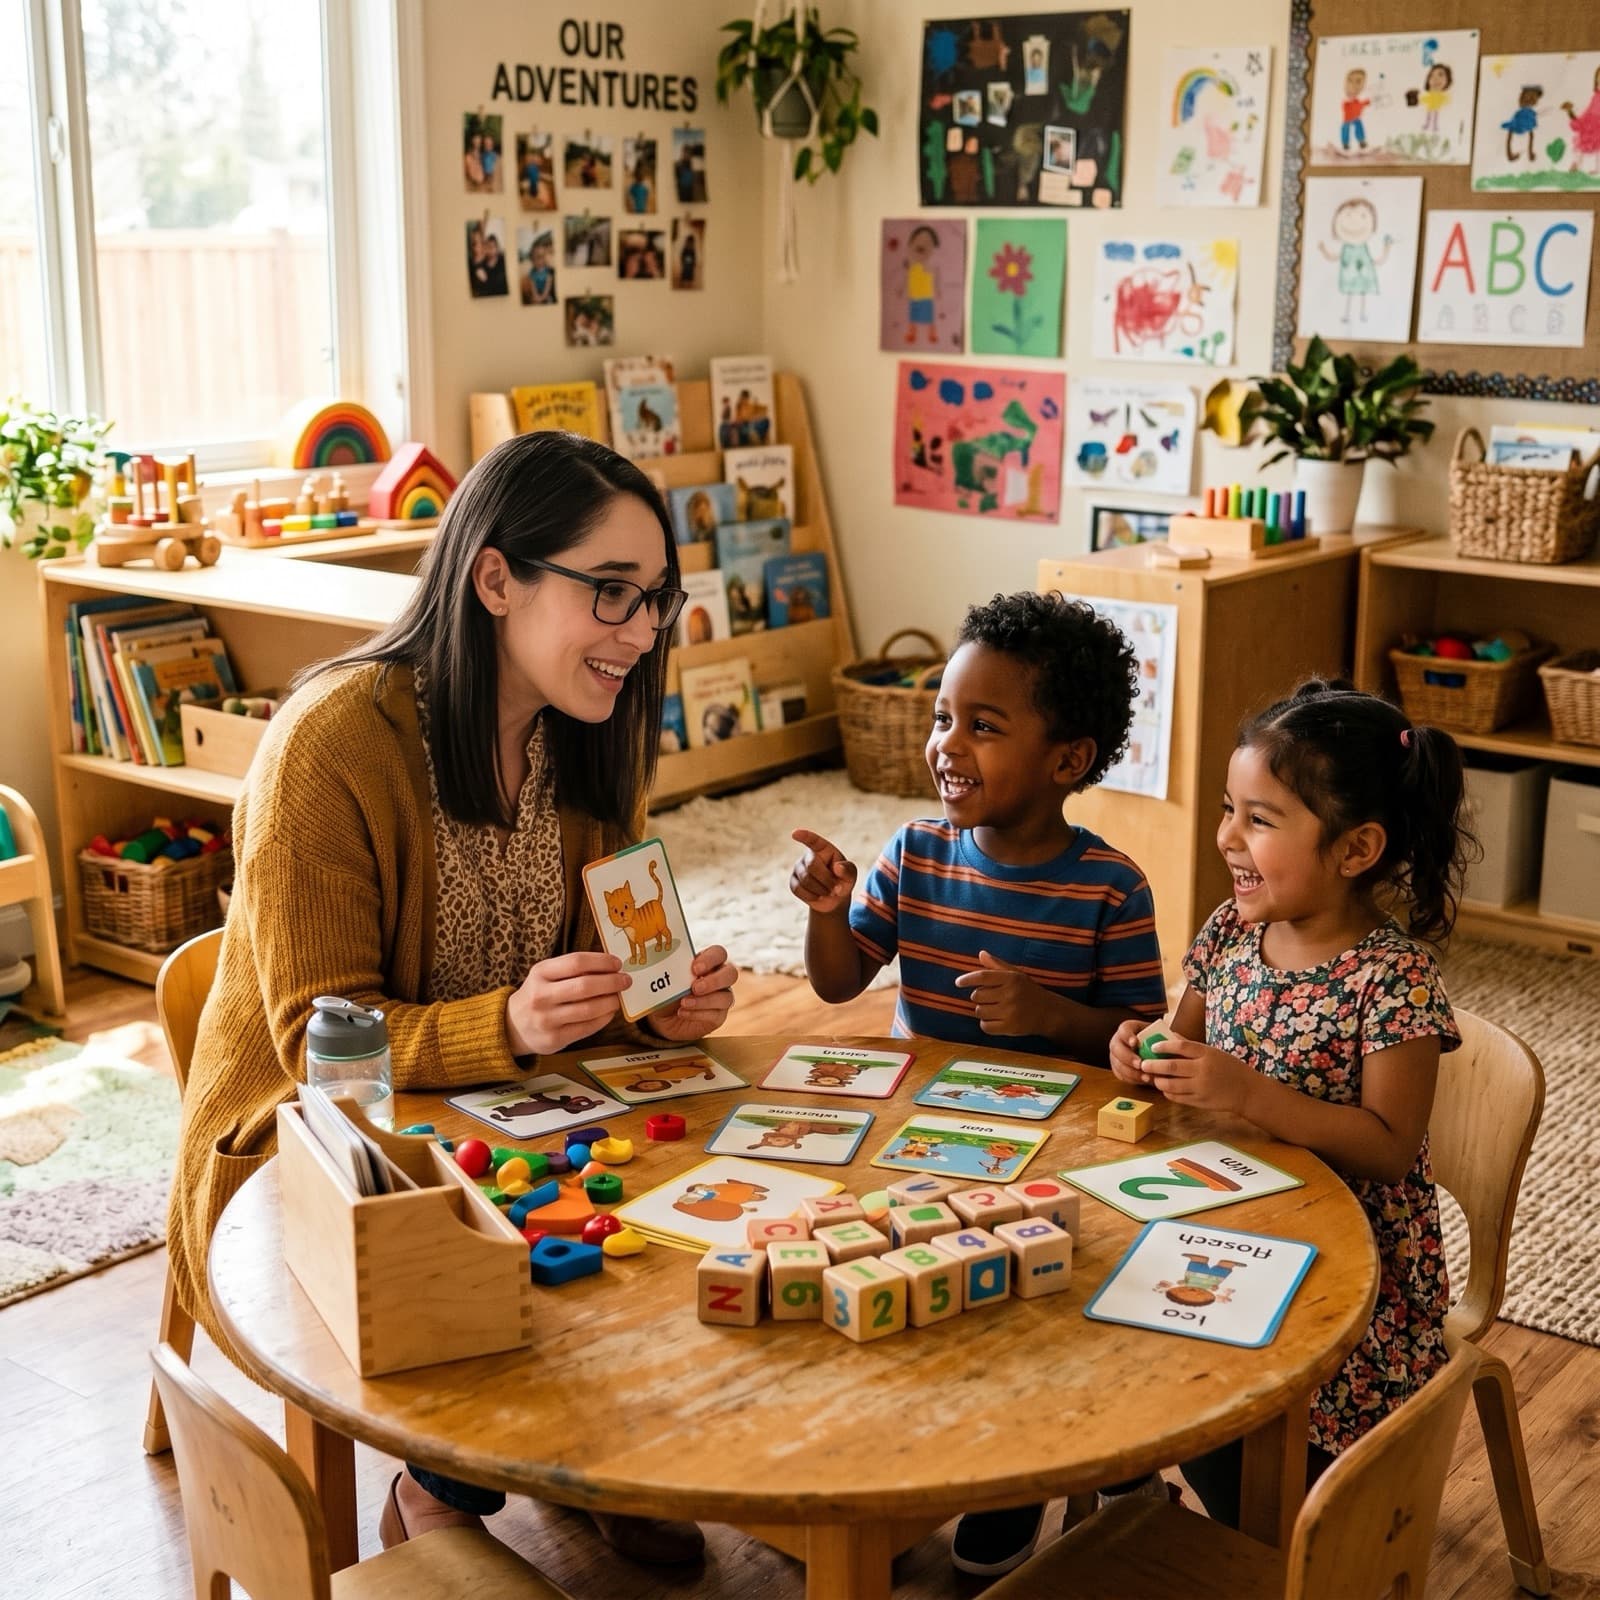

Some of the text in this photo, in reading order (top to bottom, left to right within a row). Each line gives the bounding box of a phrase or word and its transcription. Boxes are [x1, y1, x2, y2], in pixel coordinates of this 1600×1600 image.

[559, 18, 625, 61] OUR
[491, 62, 698, 113] ADVENTURES
[1431, 222, 1578, 297] ABC
[650, 971, 671, 993] cat
[716, 1253, 752, 1267] A
[905, 1249, 939, 1266] 8
[833, 1288, 850, 1327] 3
[873, 1290, 893, 1328] 2
[929, 1276, 950, 1313] 5
